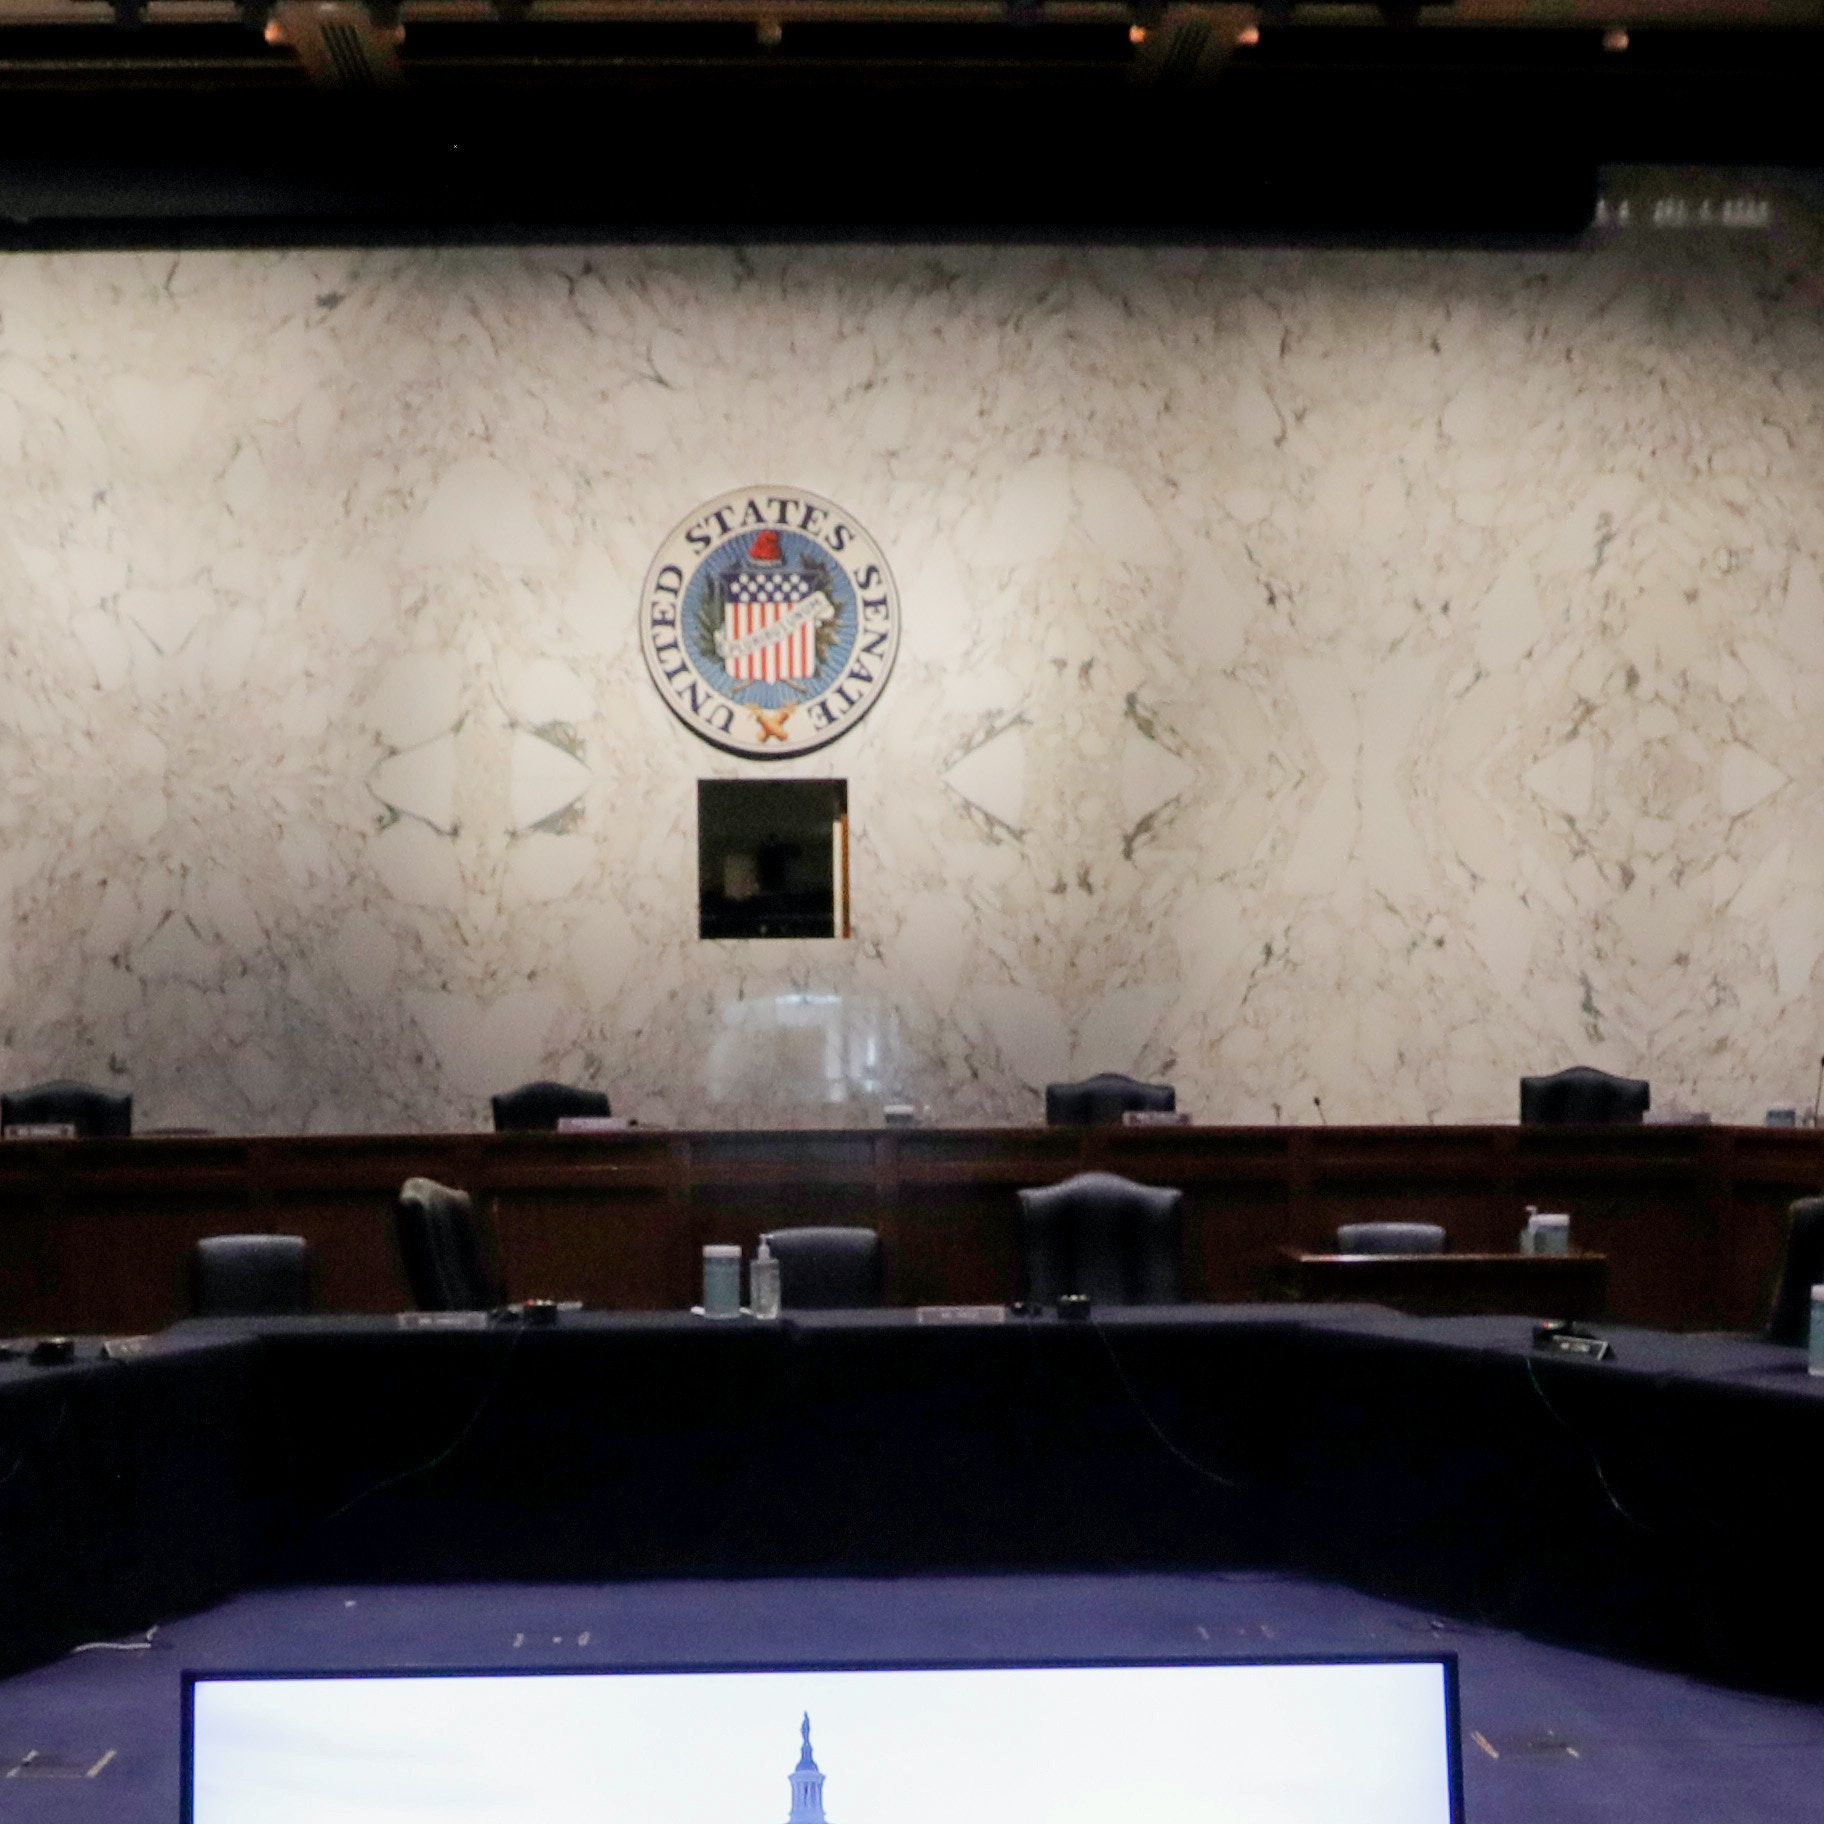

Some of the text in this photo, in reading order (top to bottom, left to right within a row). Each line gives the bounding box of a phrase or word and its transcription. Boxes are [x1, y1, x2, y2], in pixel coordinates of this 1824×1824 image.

[651, 497, 891, 735] UNITED STATES SENATE
